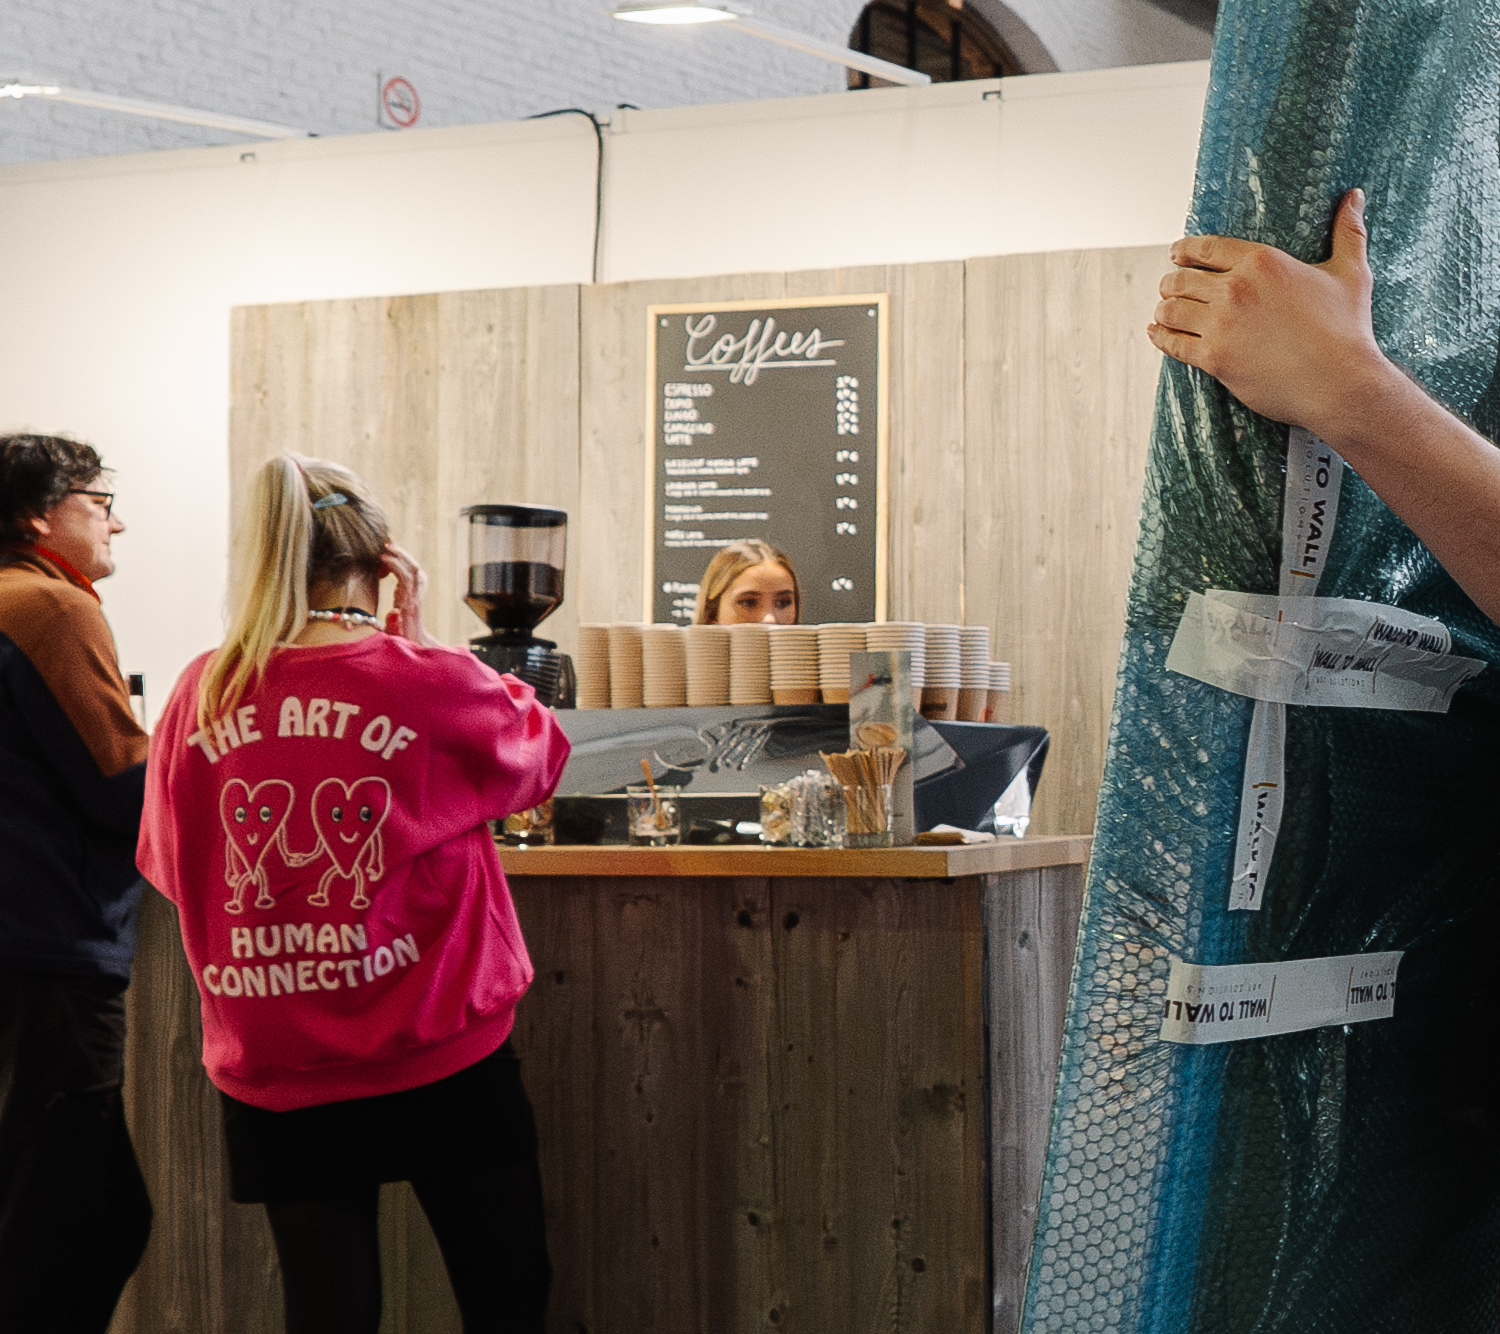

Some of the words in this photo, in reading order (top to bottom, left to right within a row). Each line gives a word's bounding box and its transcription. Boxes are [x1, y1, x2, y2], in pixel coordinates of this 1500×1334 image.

[685, 314, 845, 386] Coffees
[1315, 454, 1332, 489] TO
[1302, 499, 1327, 567] WALL
[1373, 622, 1403, 644] WALL
[1419, 634, 1445, 654] WALL
[1314, 650, 1338, 671] WALL
[1340, 654, 1356, 671] TO
[187, 703, 262, 765] THE
[278, 695, 360, 739] ART
[359, 715, 418, 761] OF
[230, 922, 369, 959] HUMAN
[202, 933, 421, 998] CONNECTION
[1350, 985, 1374, 1005] WALL
[1375, 983, 1388, 999] TO
[1219, 1001, 1235, 1021] TO
[1238, 999, 1267, 1020] WALL
